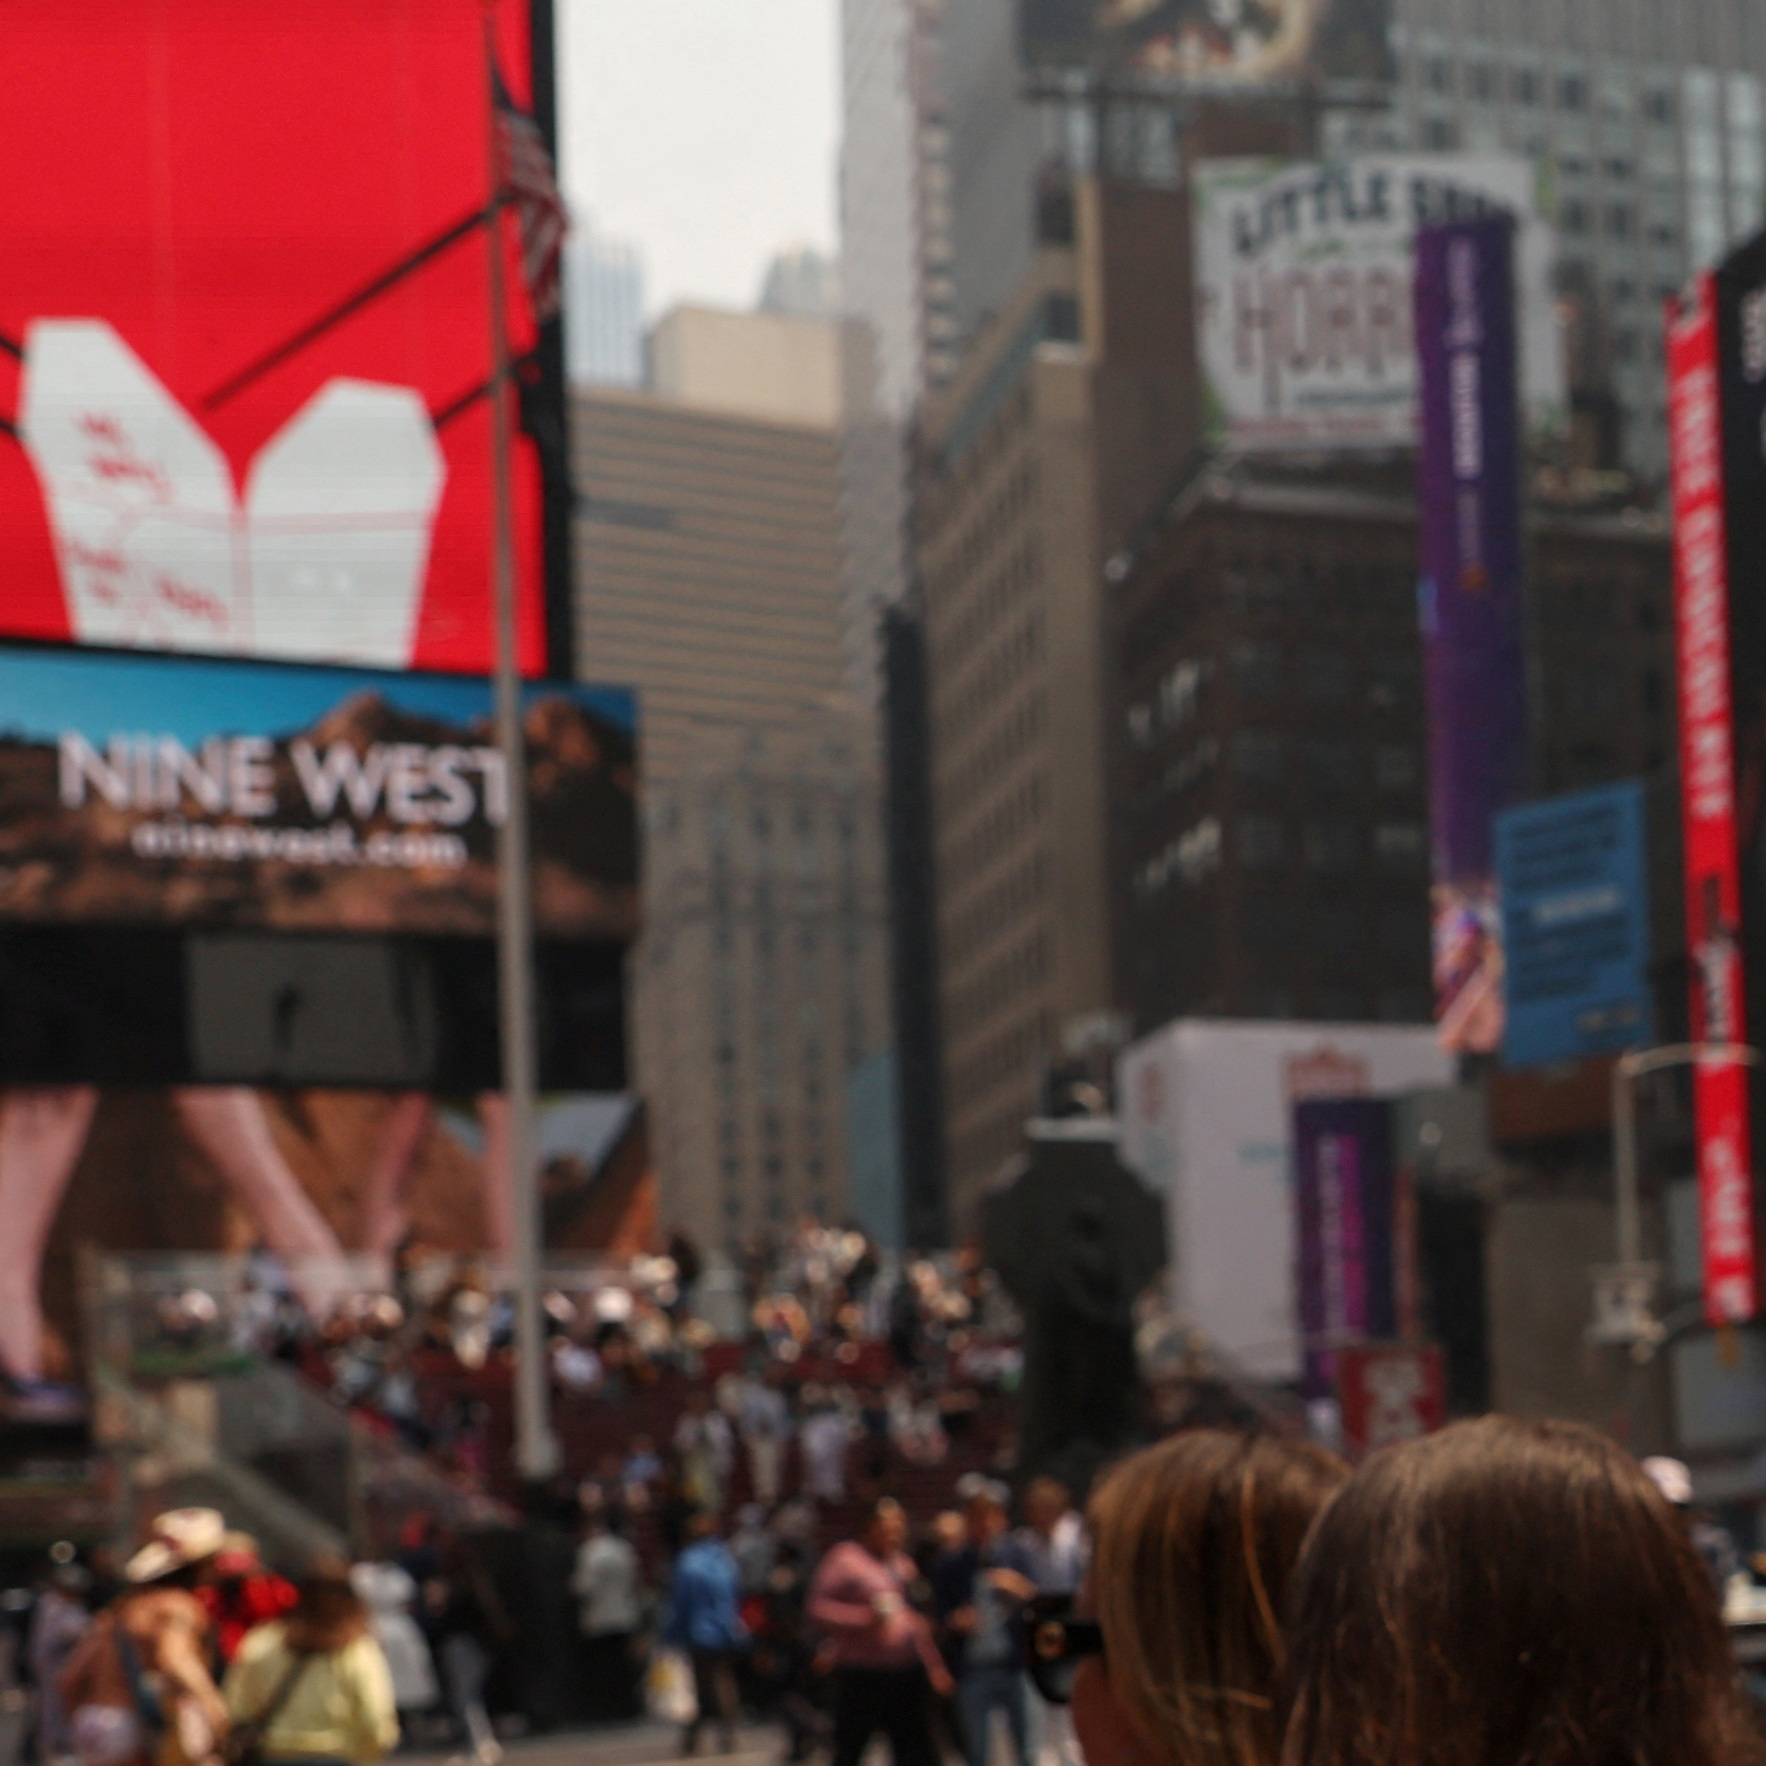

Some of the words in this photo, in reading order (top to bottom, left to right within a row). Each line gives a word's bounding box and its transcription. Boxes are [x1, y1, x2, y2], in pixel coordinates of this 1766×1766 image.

[1232, 163, 1387, 258] LITTLE
[57, 731, 277, 816] NINE
[292, 738, 510, 827] WEST
